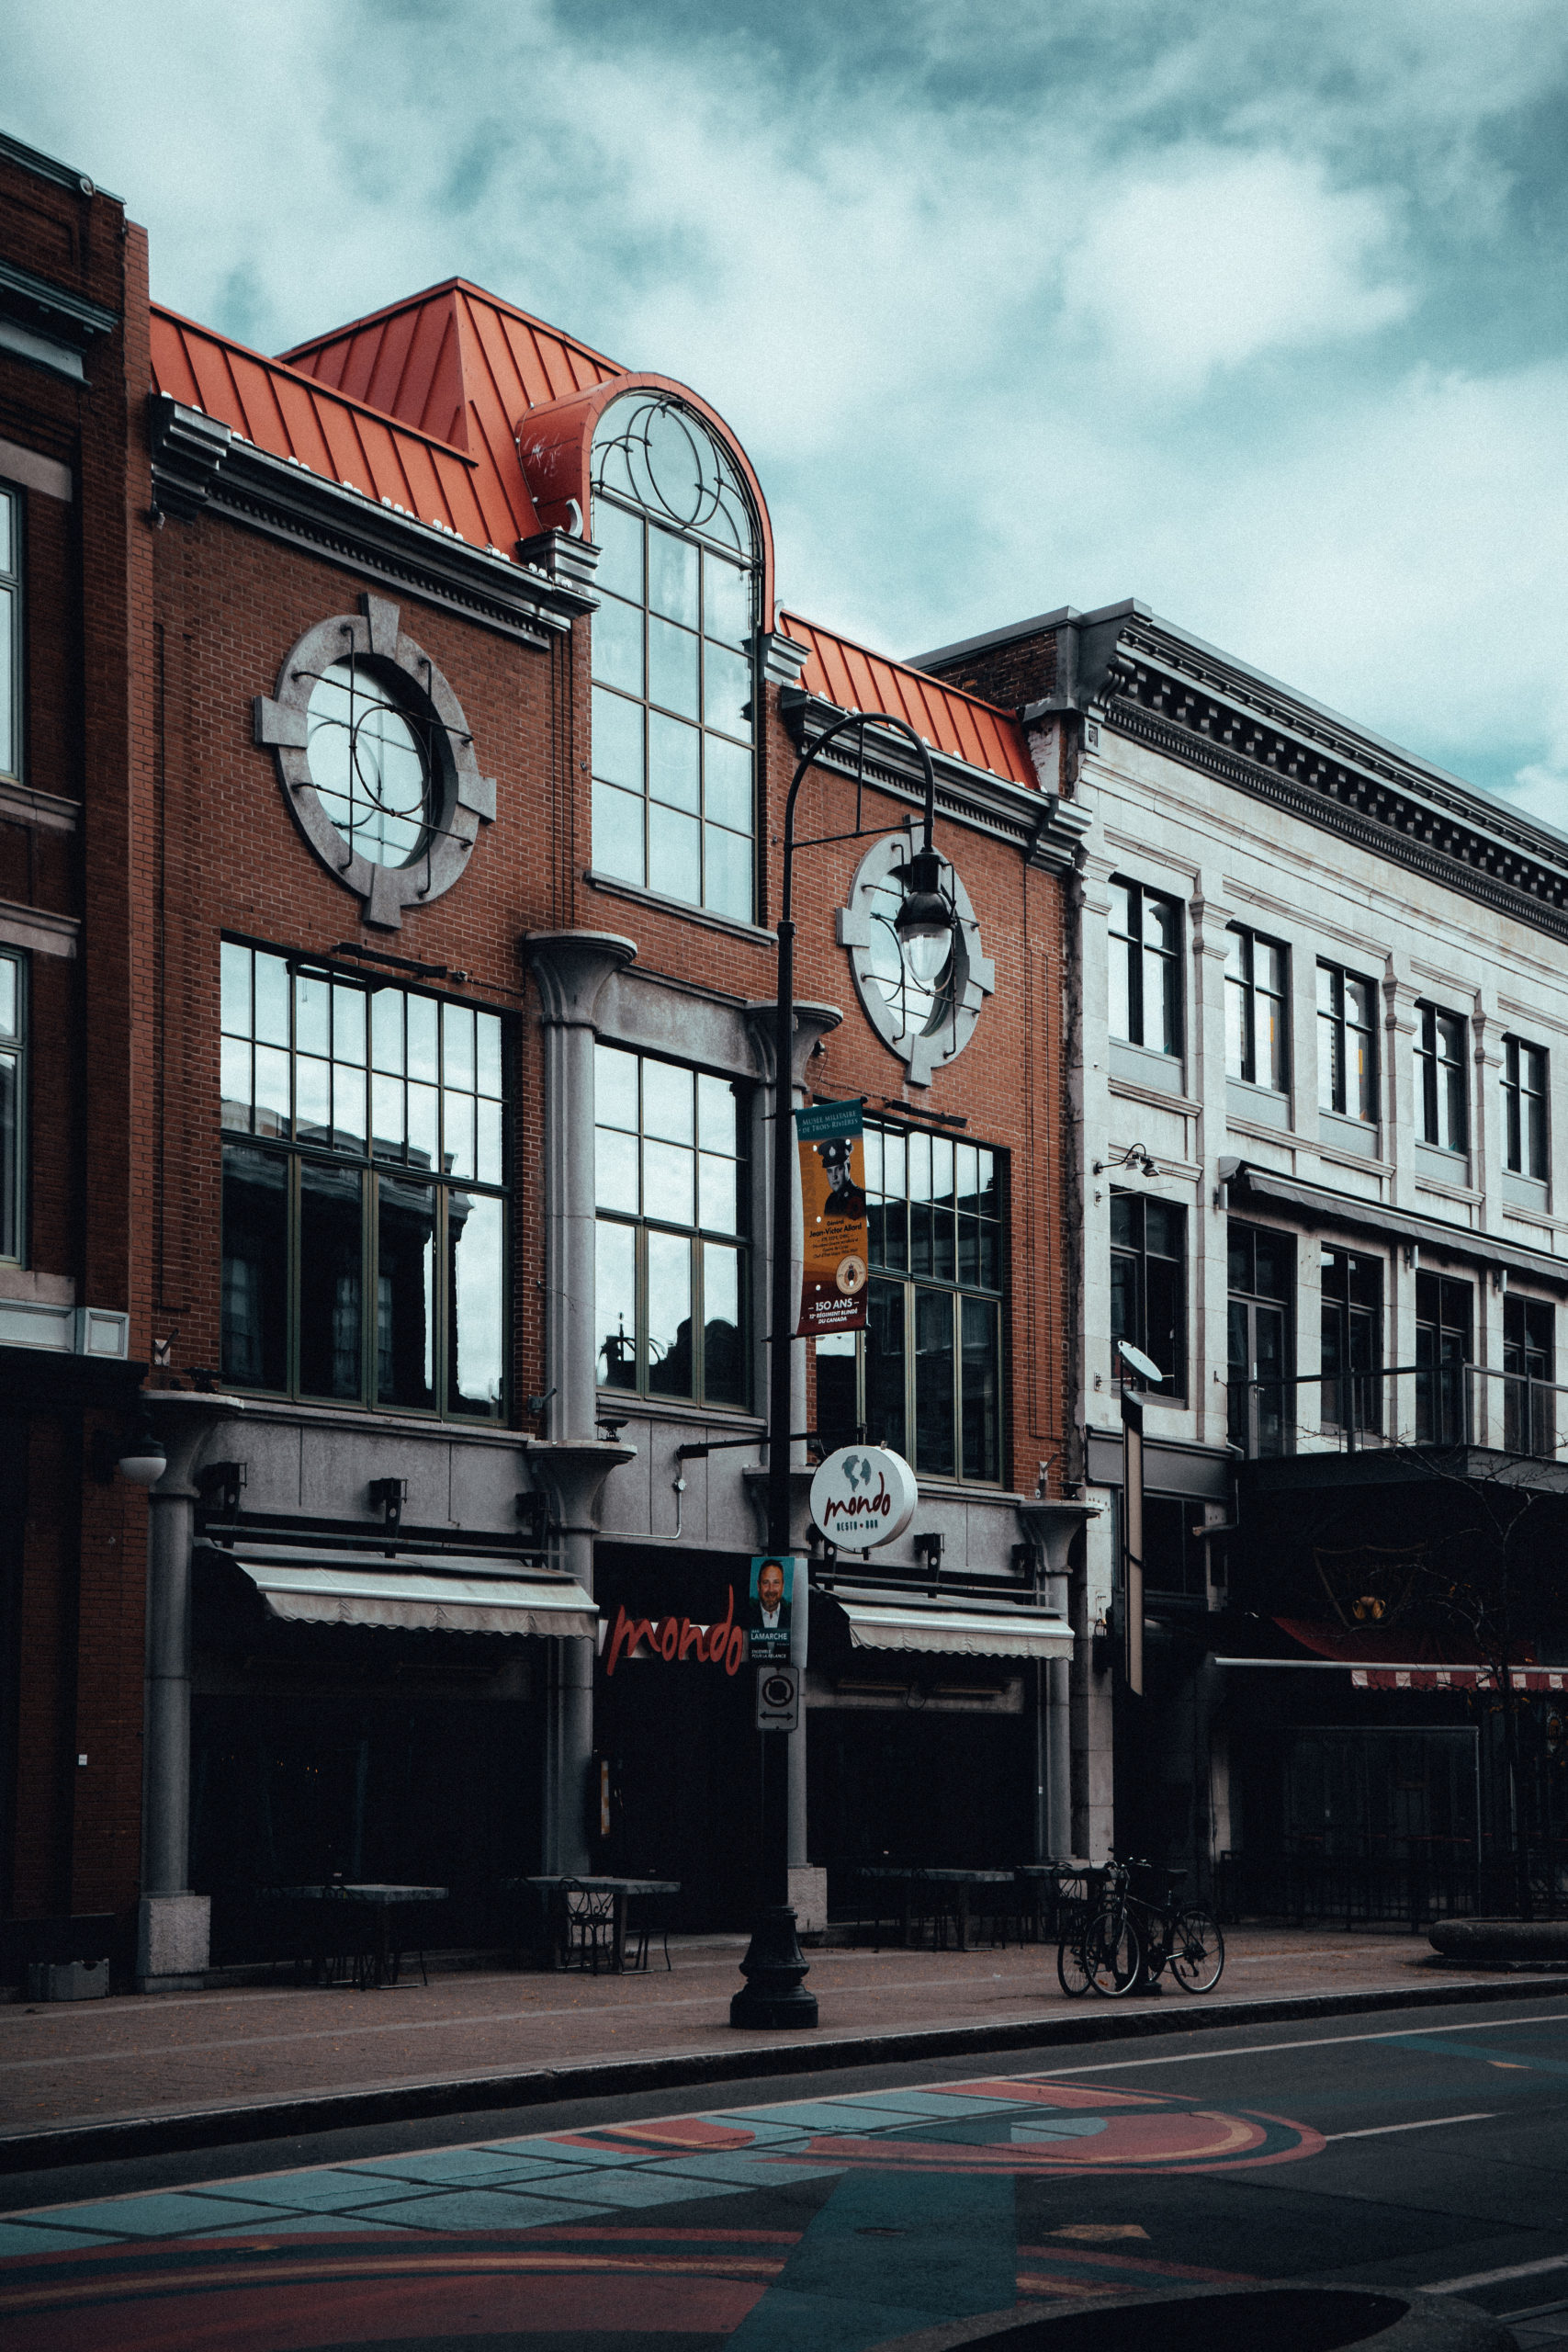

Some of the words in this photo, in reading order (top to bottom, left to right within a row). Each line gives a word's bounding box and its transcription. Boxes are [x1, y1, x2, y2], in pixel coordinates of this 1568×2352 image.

[824, 1110, 857, 1121] MILITAIRE
[809, 1227, 842, 1238] Jean-Victor
[844, 1222, 862, 1232] Allard
[815, 1300, 831, 1312] 150
[832, 1297, 852, 1309] ANS
[826, 1316, 847, 1324] CANADA
[824, 1471, 891, 1527] mondo
[606, 1583, 744, 1677] mondo
